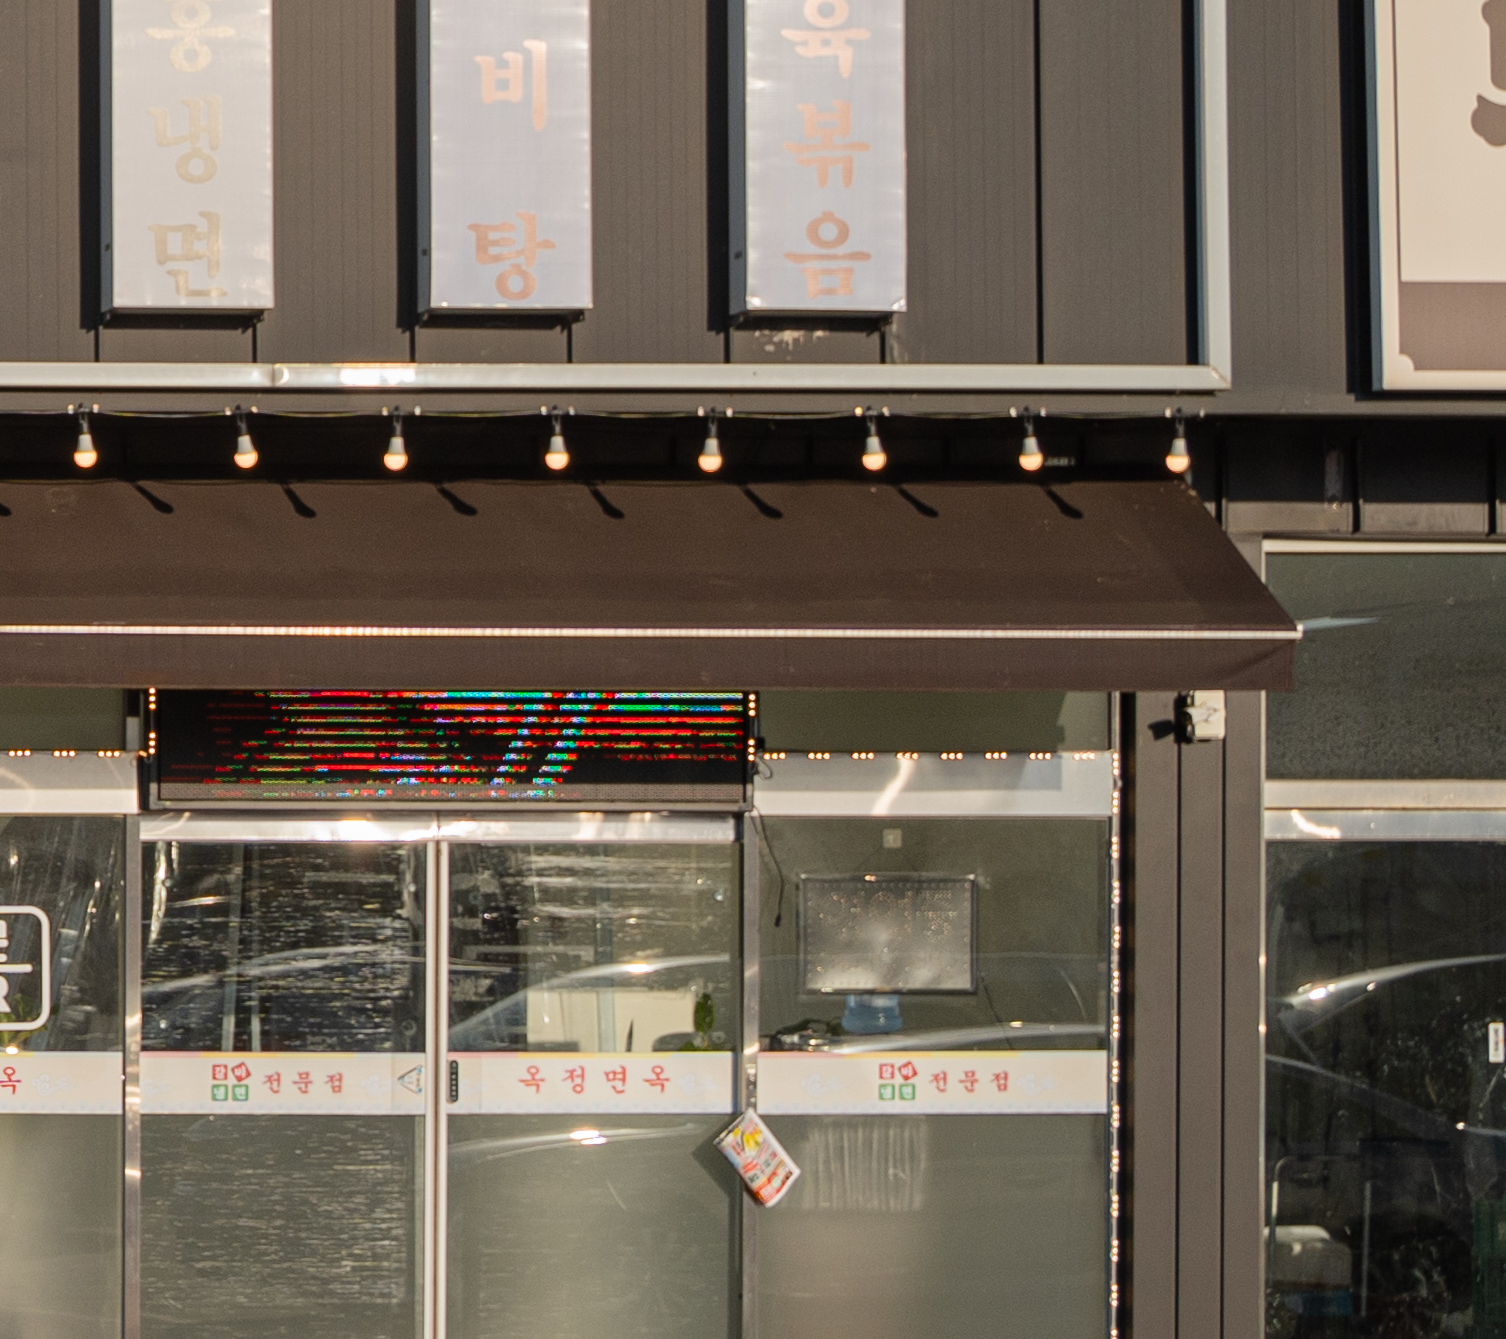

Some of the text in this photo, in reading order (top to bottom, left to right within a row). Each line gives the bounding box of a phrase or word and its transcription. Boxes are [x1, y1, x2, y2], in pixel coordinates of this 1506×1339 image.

[261, 1070, 344, 1095] 전문점
[518, 1064, 671, 1095] 옥정면옥
[928, 1069, 1009, 1093] 전문점
